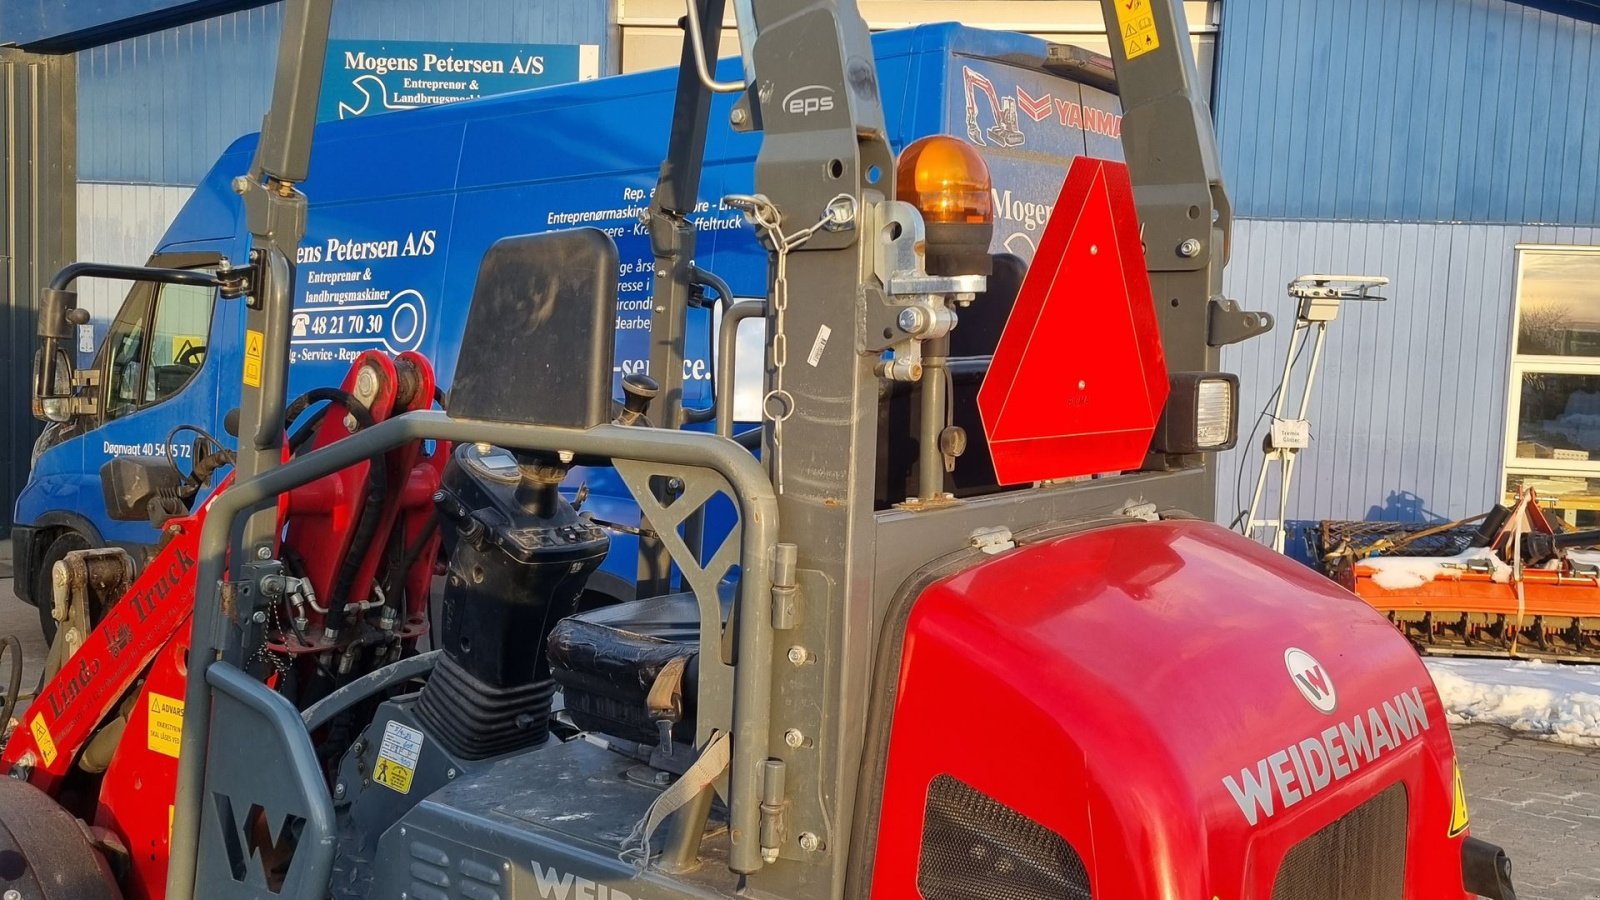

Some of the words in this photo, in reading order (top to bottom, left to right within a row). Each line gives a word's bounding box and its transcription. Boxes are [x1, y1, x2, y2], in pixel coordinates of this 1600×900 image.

[344, 51, 418, 75] Mogens
[423, 53, 504, 74] Petersen
[509, 56, 545, 75] A/S
[403, 77, 467, 92] Entreprenør
[469, 79, 480, 90] &
[789, 96, 834, 117] eps
[623, 187, 646, 202] Rep.
[324, 238, 399, 262] Petersen
[401, 229, 437, 258] A/S
[307, 270, 361, 286] Entreprenør
[363, 267, 373, 281] &
[312, 315, 328, 335] 48
[330, 315, 344, 334] 21
[348, 315, 364, 334] 70
[366, 314, 383, 334] 30
[301, 347, 333, 361] Service
[142, 443, 154, 456] 40
[155, 443, 166, 456] 54
[180, 445, 191, 458] 72
[130, 547, 195, 622] Truck
[1222, 686, 1430, 827] WEIDEMANN
